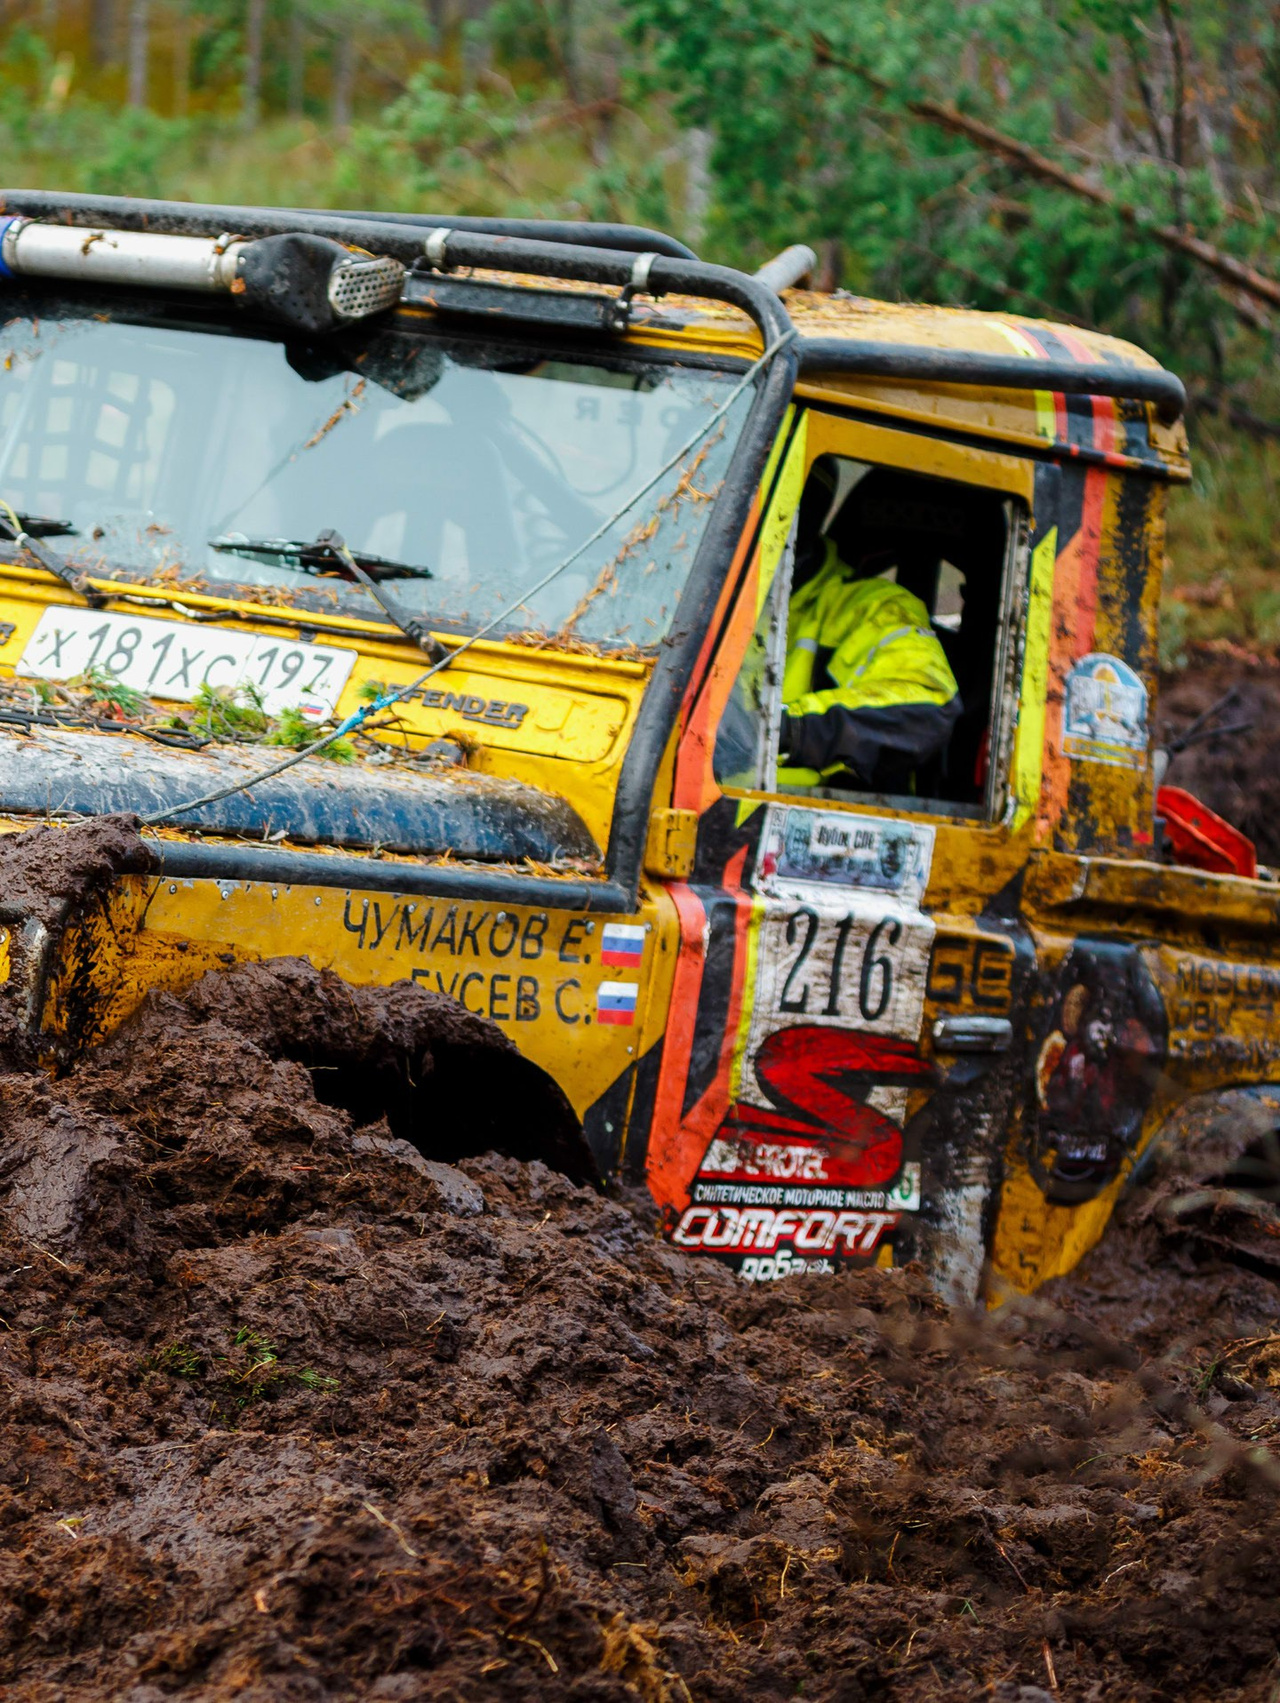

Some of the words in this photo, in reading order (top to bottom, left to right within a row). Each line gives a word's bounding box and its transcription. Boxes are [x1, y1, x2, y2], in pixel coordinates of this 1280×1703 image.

[258, 647, 334, 689] 197
[343, 898, 550, 959] ЧУМАКОВ
[779, 906, 903, 1021] 216
[694, 1183, 783, 1206] СИНТЕТИЧЕСКОЕ
[784, 1188, 844, 1208] МОТОРНОЕ
[845, 1192, 885, 1210] МАСЛО
[672, 1206, 897, 1250] COMFORT
